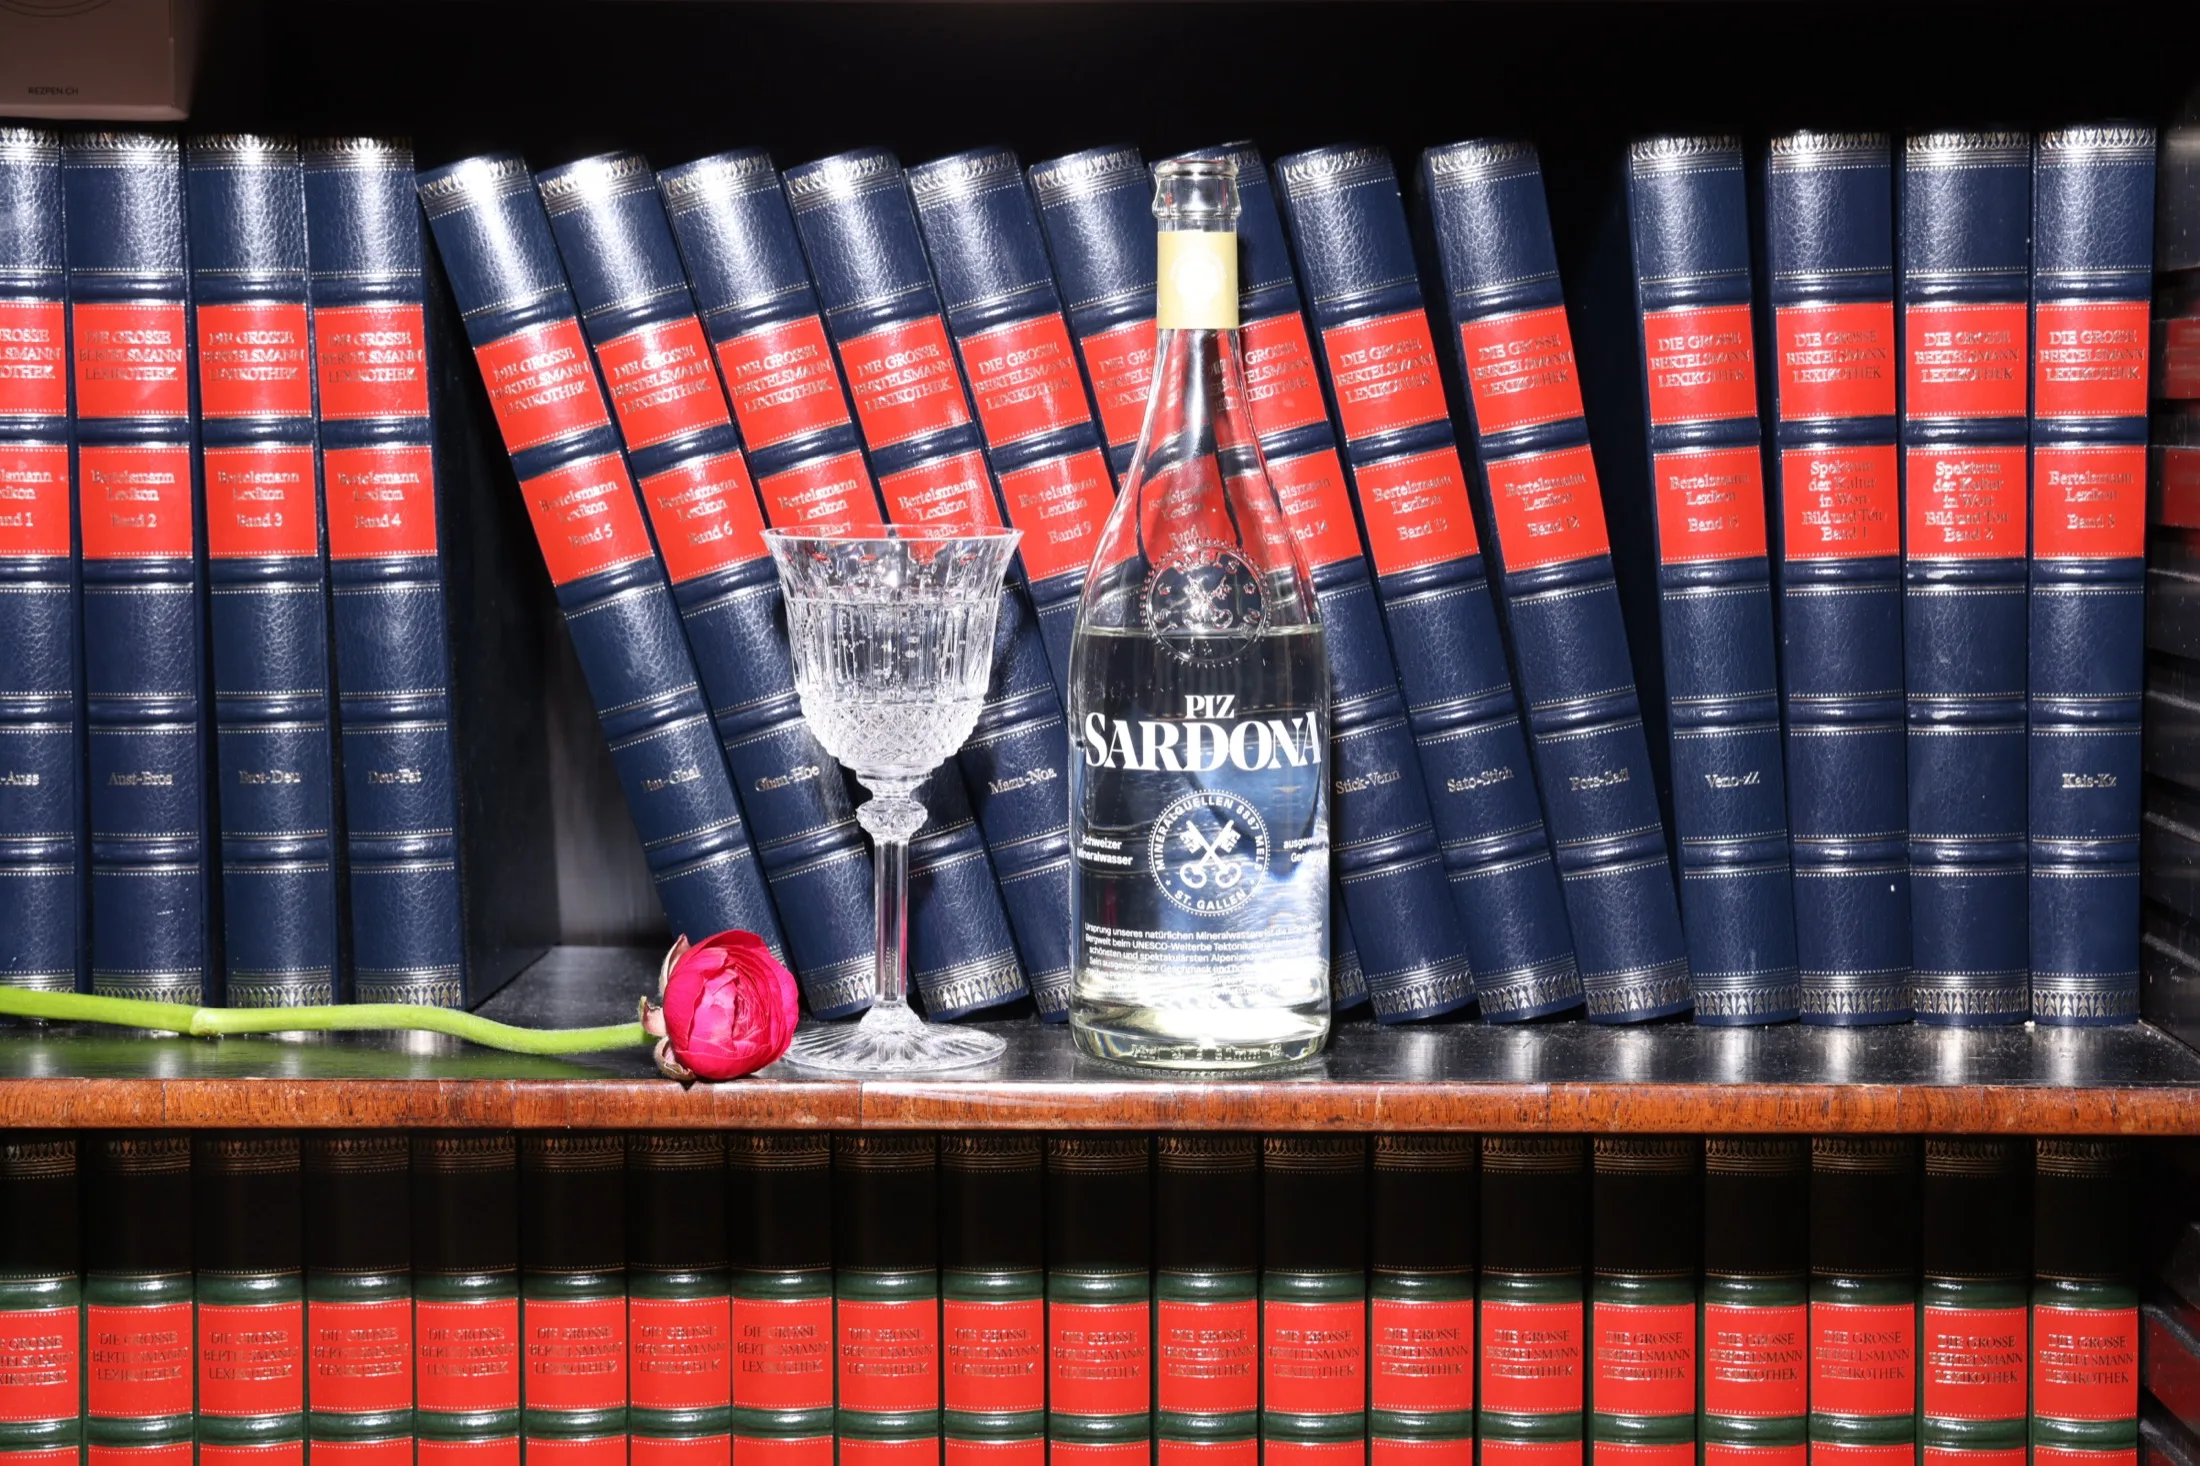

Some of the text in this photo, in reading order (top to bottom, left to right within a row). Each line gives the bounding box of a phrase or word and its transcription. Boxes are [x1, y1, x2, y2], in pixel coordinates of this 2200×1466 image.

[1810, 460, 1875, 478] Spektrum
[1935, 461, 2001, 479] Spektrum
[1808, 478, 1832, 492] der
[1933, 477, 2003, 492] der Kultur
[1819, 493, 1867, 508] in Wort
[1942, 493, 1994, 508] in Wort
[1801, 511, 1830, 525] Bild
[1925, 511, 1953, 525] Bild
[1821, 526, 1857, 542] Band
[1943, 527, 1993, 543] Band 2
[1184, 694, 1236, 719] PIZ
[1085, 711, 1322, 772] SARDONA
[0, 771, 40, 786] -Auss
[1153, 796, 1233, 871] MINERALQUELLEN
[1253, 835, 1264, 871] MELS
[1076, 846, 1133, 866] Mineralwasser
[1174, 889, 1247, 911] ST. GALLEN
[1112, 928, 1144, 938] unseres
[1145, 930, 1194, 940] natürlichen
[1112, 938, 1131, 949] beim
[1132, 940, 1212, 951] UNESCO-Welterbe
[1123, 951, 1138, 960] und
[1139, 952, 1209, 963] spektakulärsten
